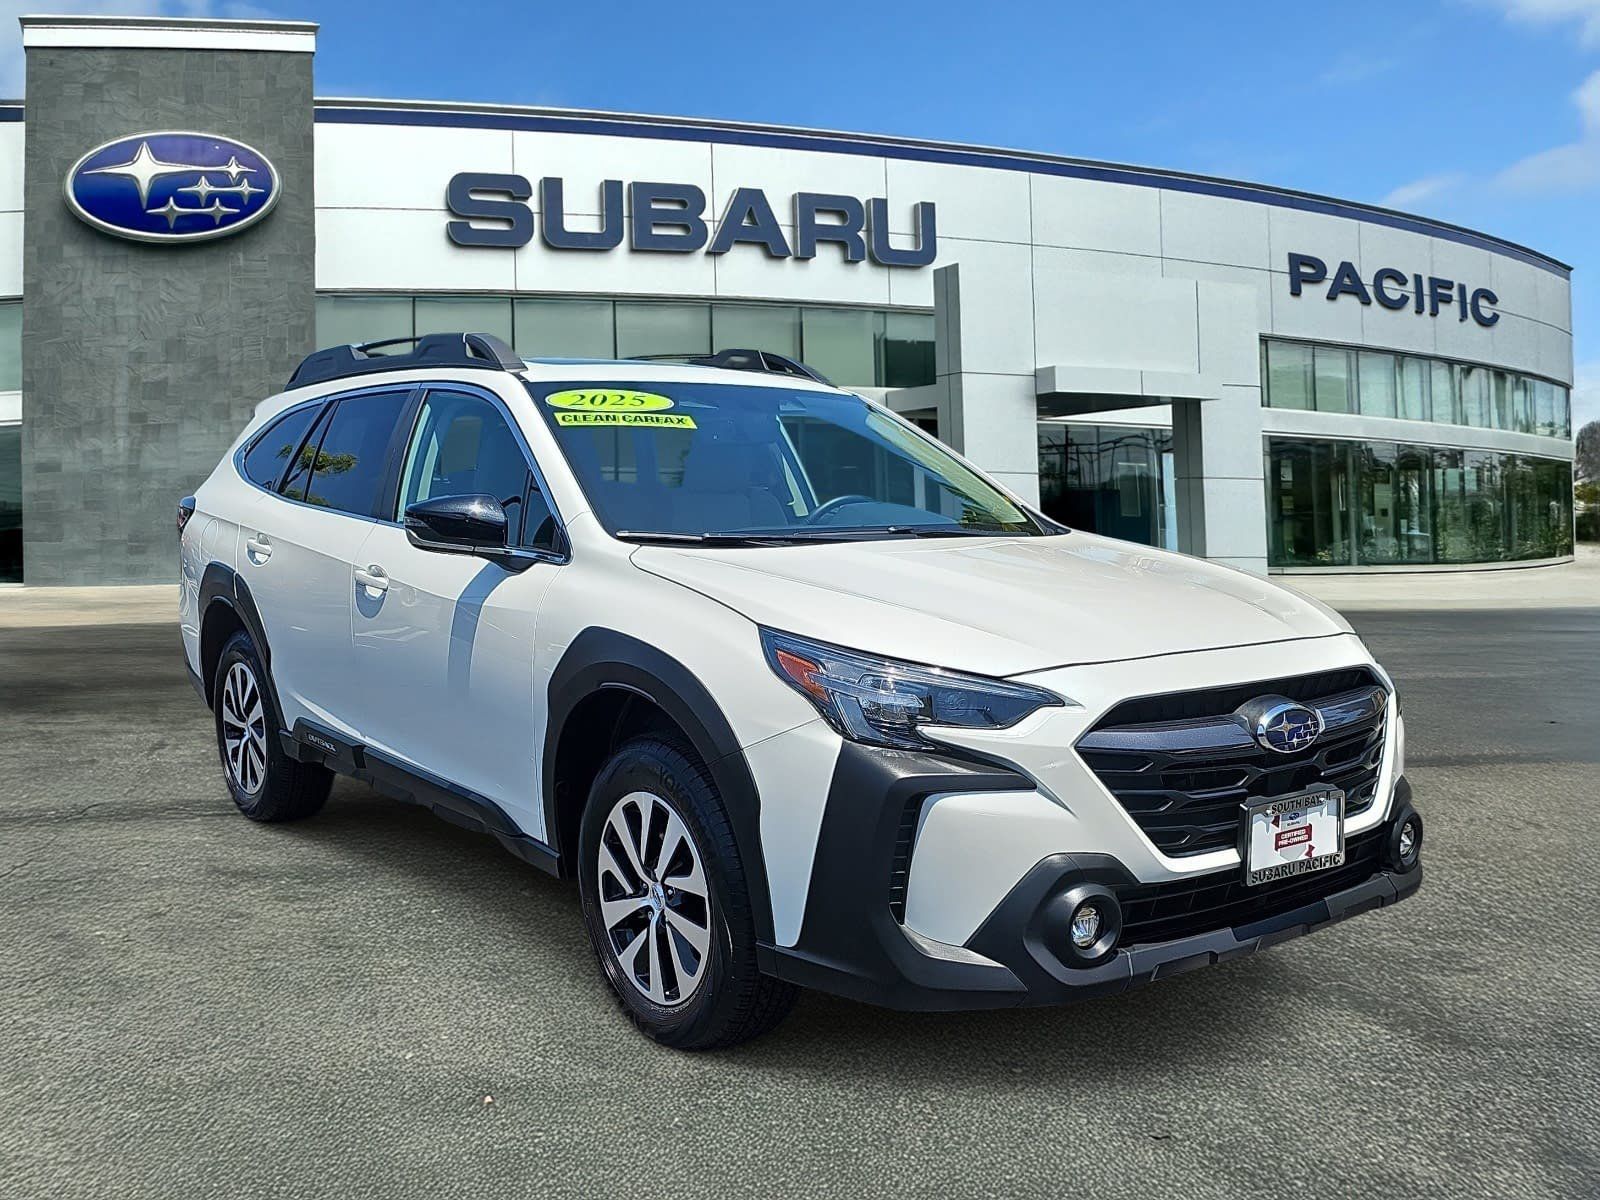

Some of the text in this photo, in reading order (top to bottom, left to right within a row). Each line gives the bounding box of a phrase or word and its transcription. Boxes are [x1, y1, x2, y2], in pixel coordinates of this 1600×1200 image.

[446, 172, 937, 267] SUBARU
[1288, 252, 1500, 327] PACIFIC
[568, 394, 647, 407] 2025
[561, 414, 686, 425] CLEAN CARFAX
[1271, 793, 1325, 815] SOUTH BAY
[1251, 853, 1341, 884] SUBARU PACIFIC
